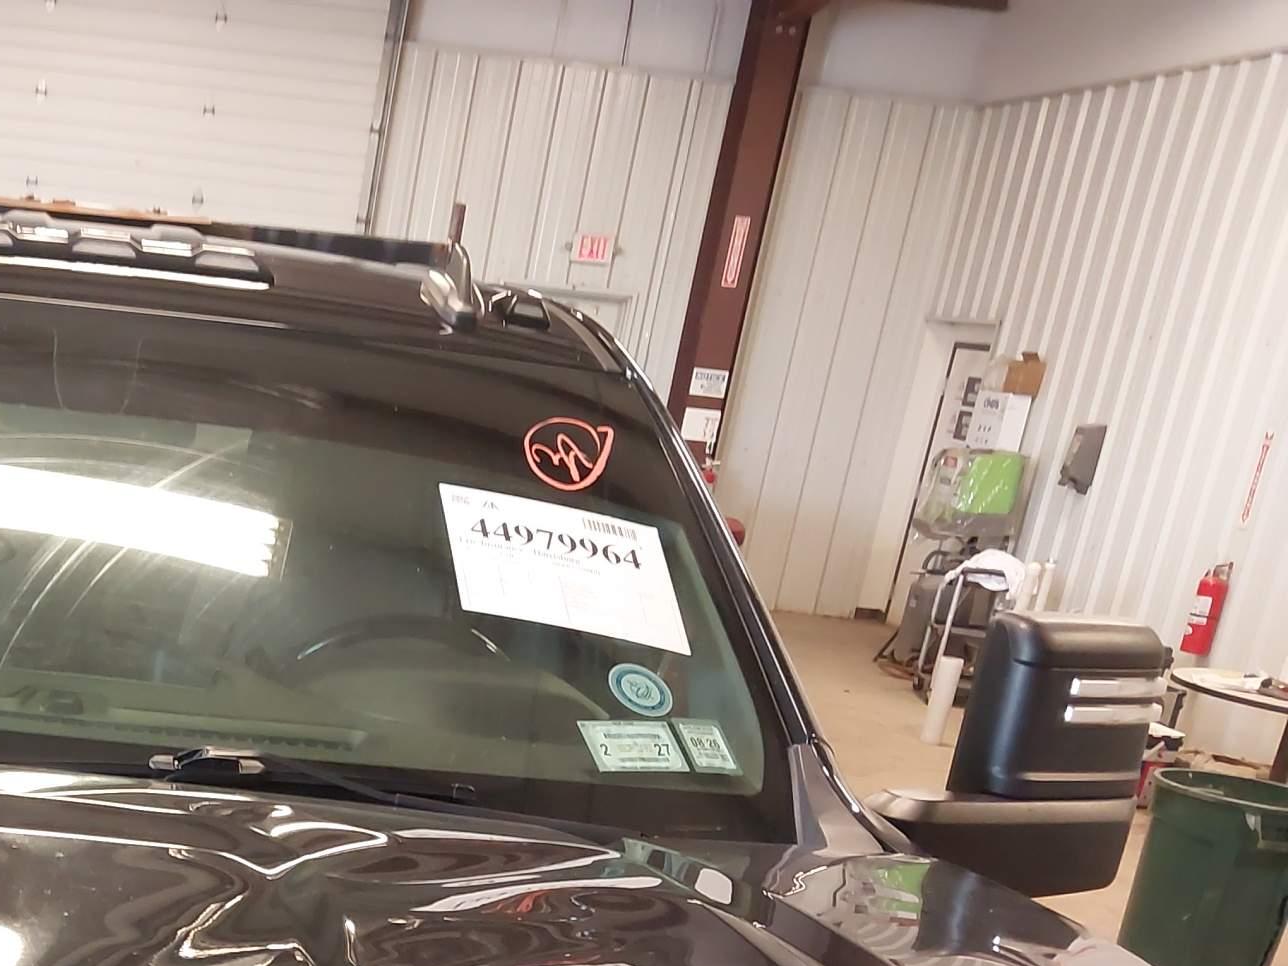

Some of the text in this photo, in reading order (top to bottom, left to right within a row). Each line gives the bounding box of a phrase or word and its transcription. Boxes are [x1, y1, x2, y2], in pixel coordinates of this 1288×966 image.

[578, 235, 608, 260] EXIT
[471, 518, 641, 569] 44979964
[600, 744, 671, 756] 2 27
